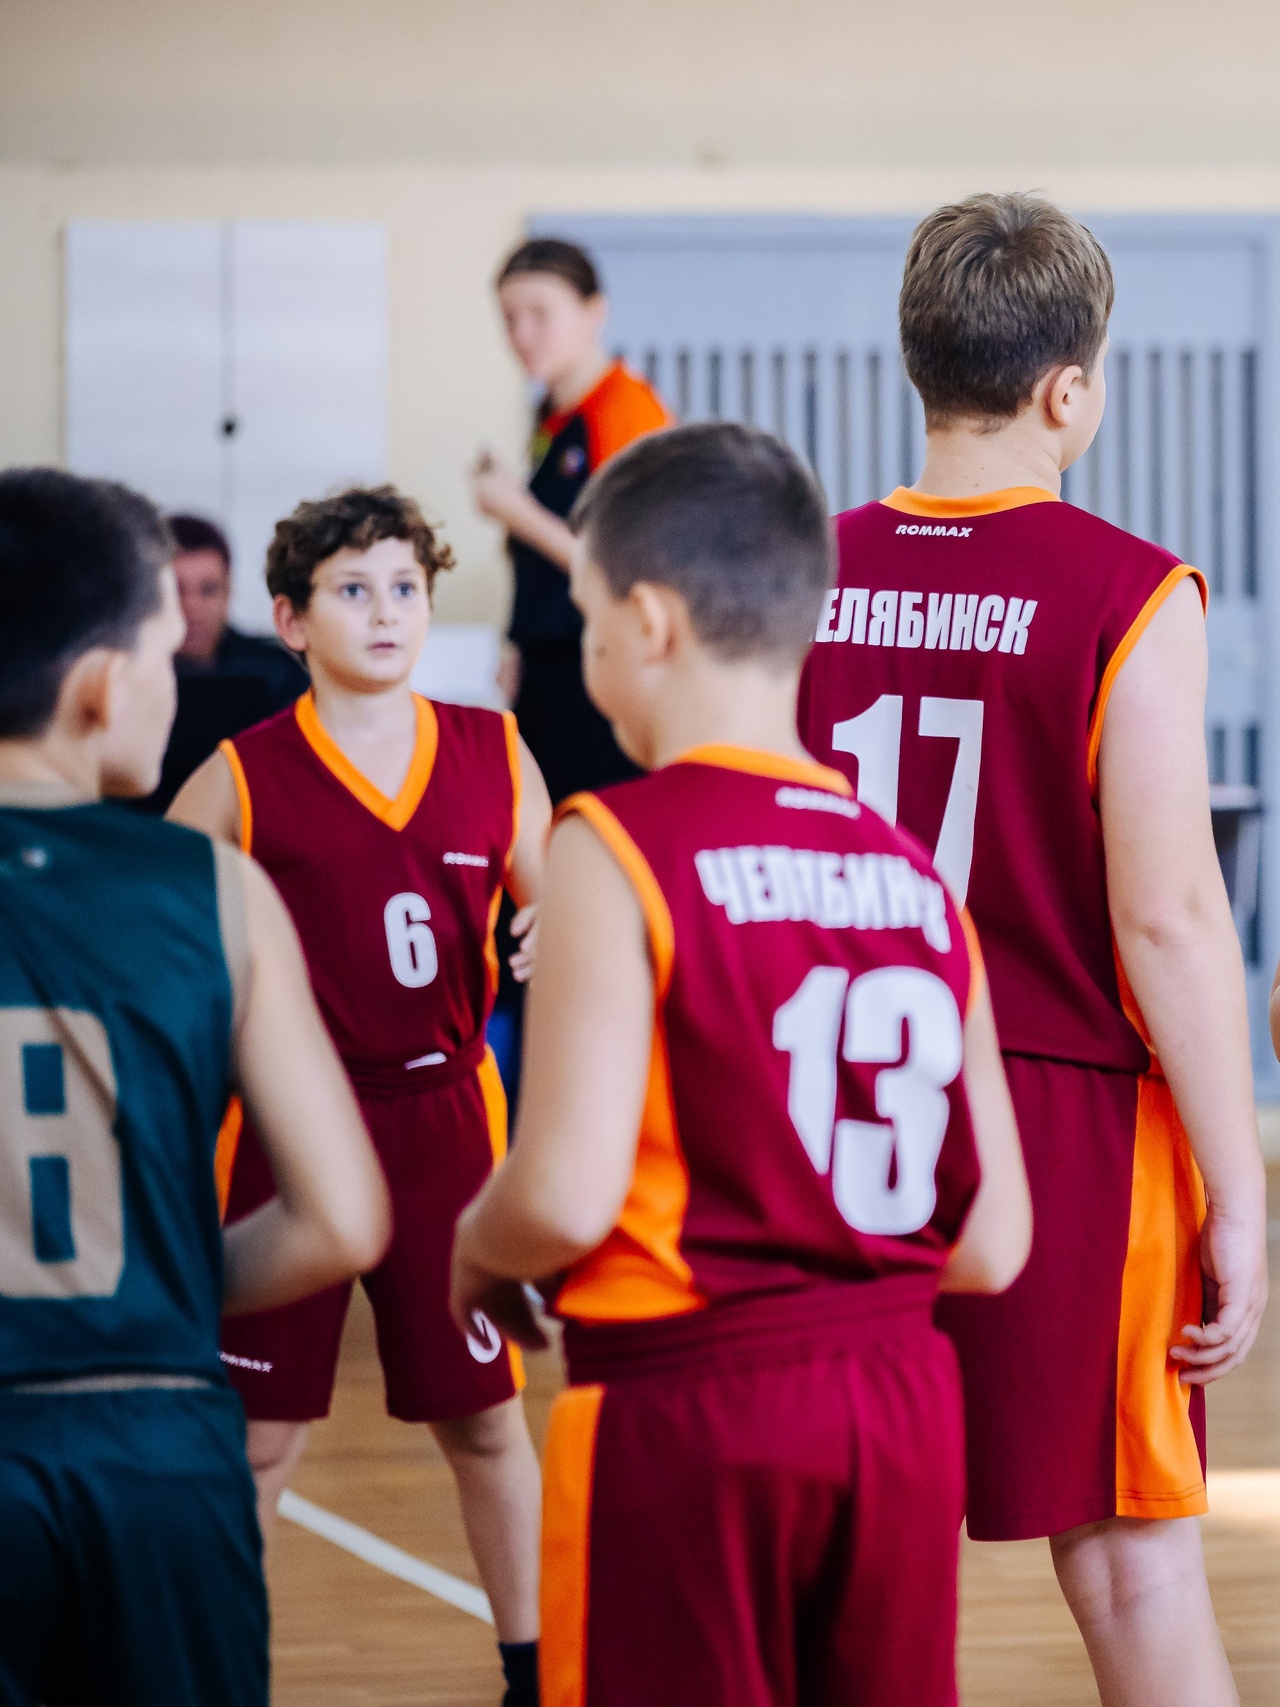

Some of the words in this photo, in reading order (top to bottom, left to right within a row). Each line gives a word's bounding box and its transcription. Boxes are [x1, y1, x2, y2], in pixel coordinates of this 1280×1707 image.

[895, 524, 973, 538] ROMMAX
[812, 587, 1038, 656] ЕЛЯБИНСК
[832, 694, 984, 911] 17
[383, 891, 438, 988] 6
[773, 966, 963, 1236] 13
